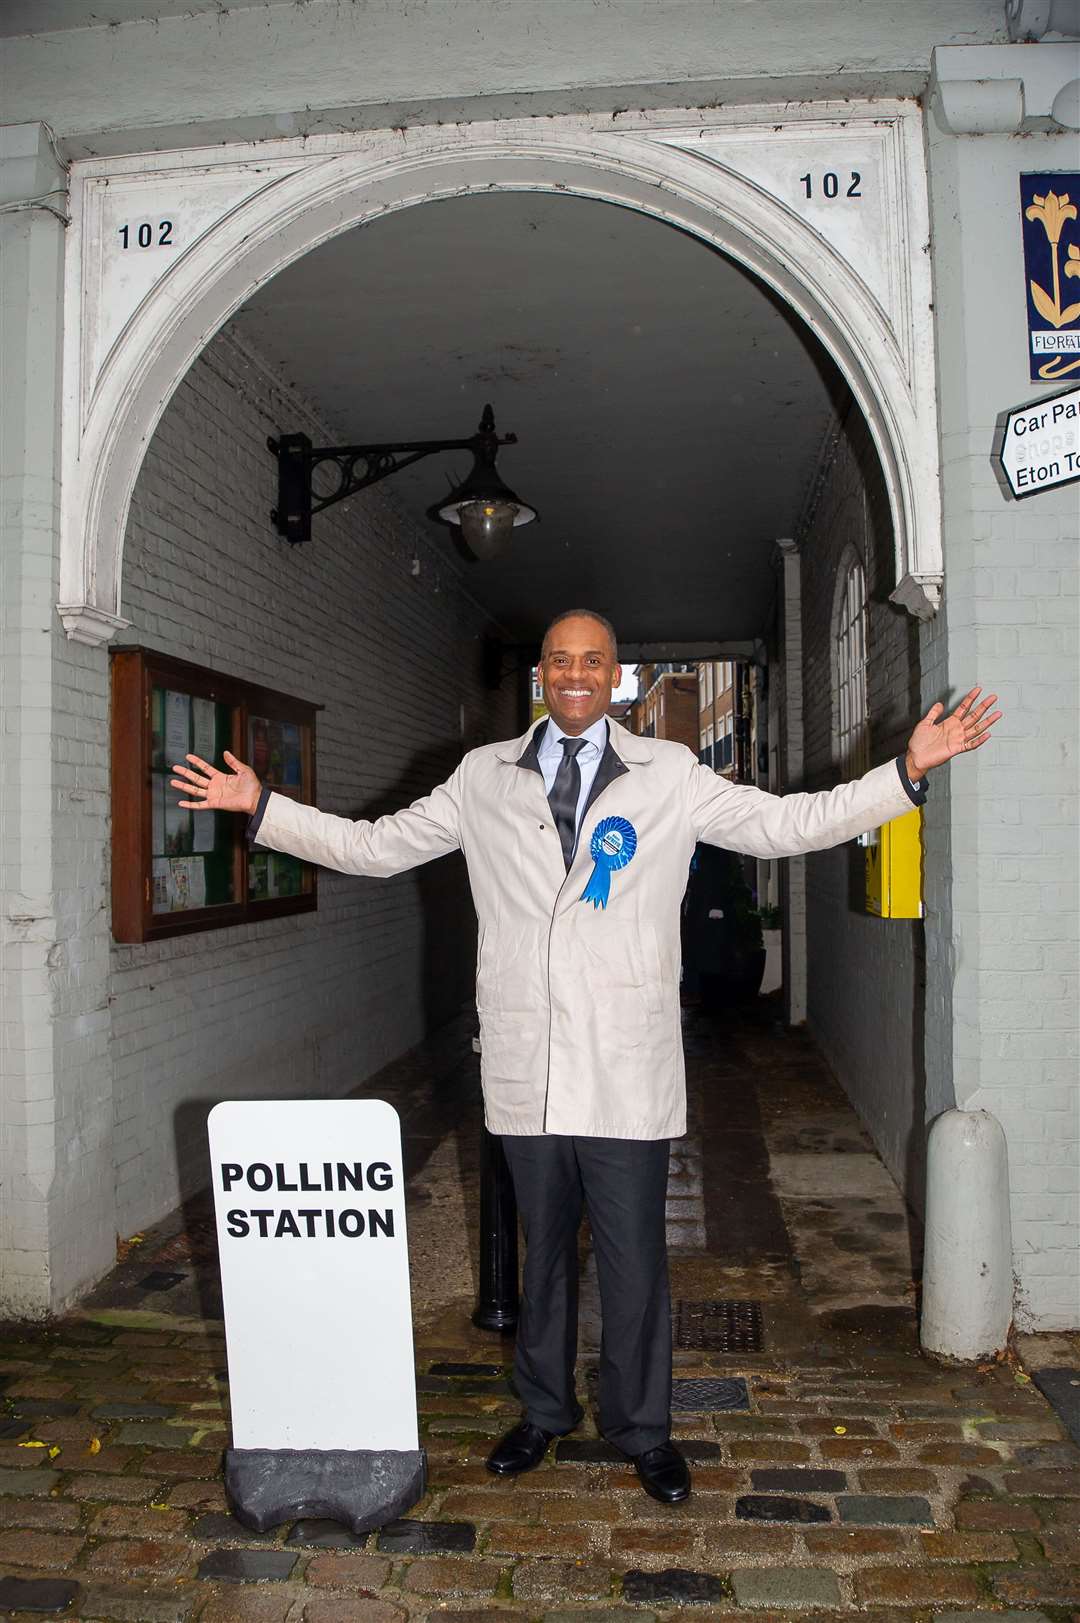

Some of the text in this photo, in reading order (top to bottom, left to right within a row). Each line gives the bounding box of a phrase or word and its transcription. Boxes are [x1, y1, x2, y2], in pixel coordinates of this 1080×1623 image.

[800, 171, 862, 199] 102
[118, 220, 173, 249] 102
[1013, 401, 1080, 437] Car Pa
[1016, 462, 1060, 488] Eton
[220, 1161, 394, 1192] POLLING
[226, 1208, 395, 1238] STATION
